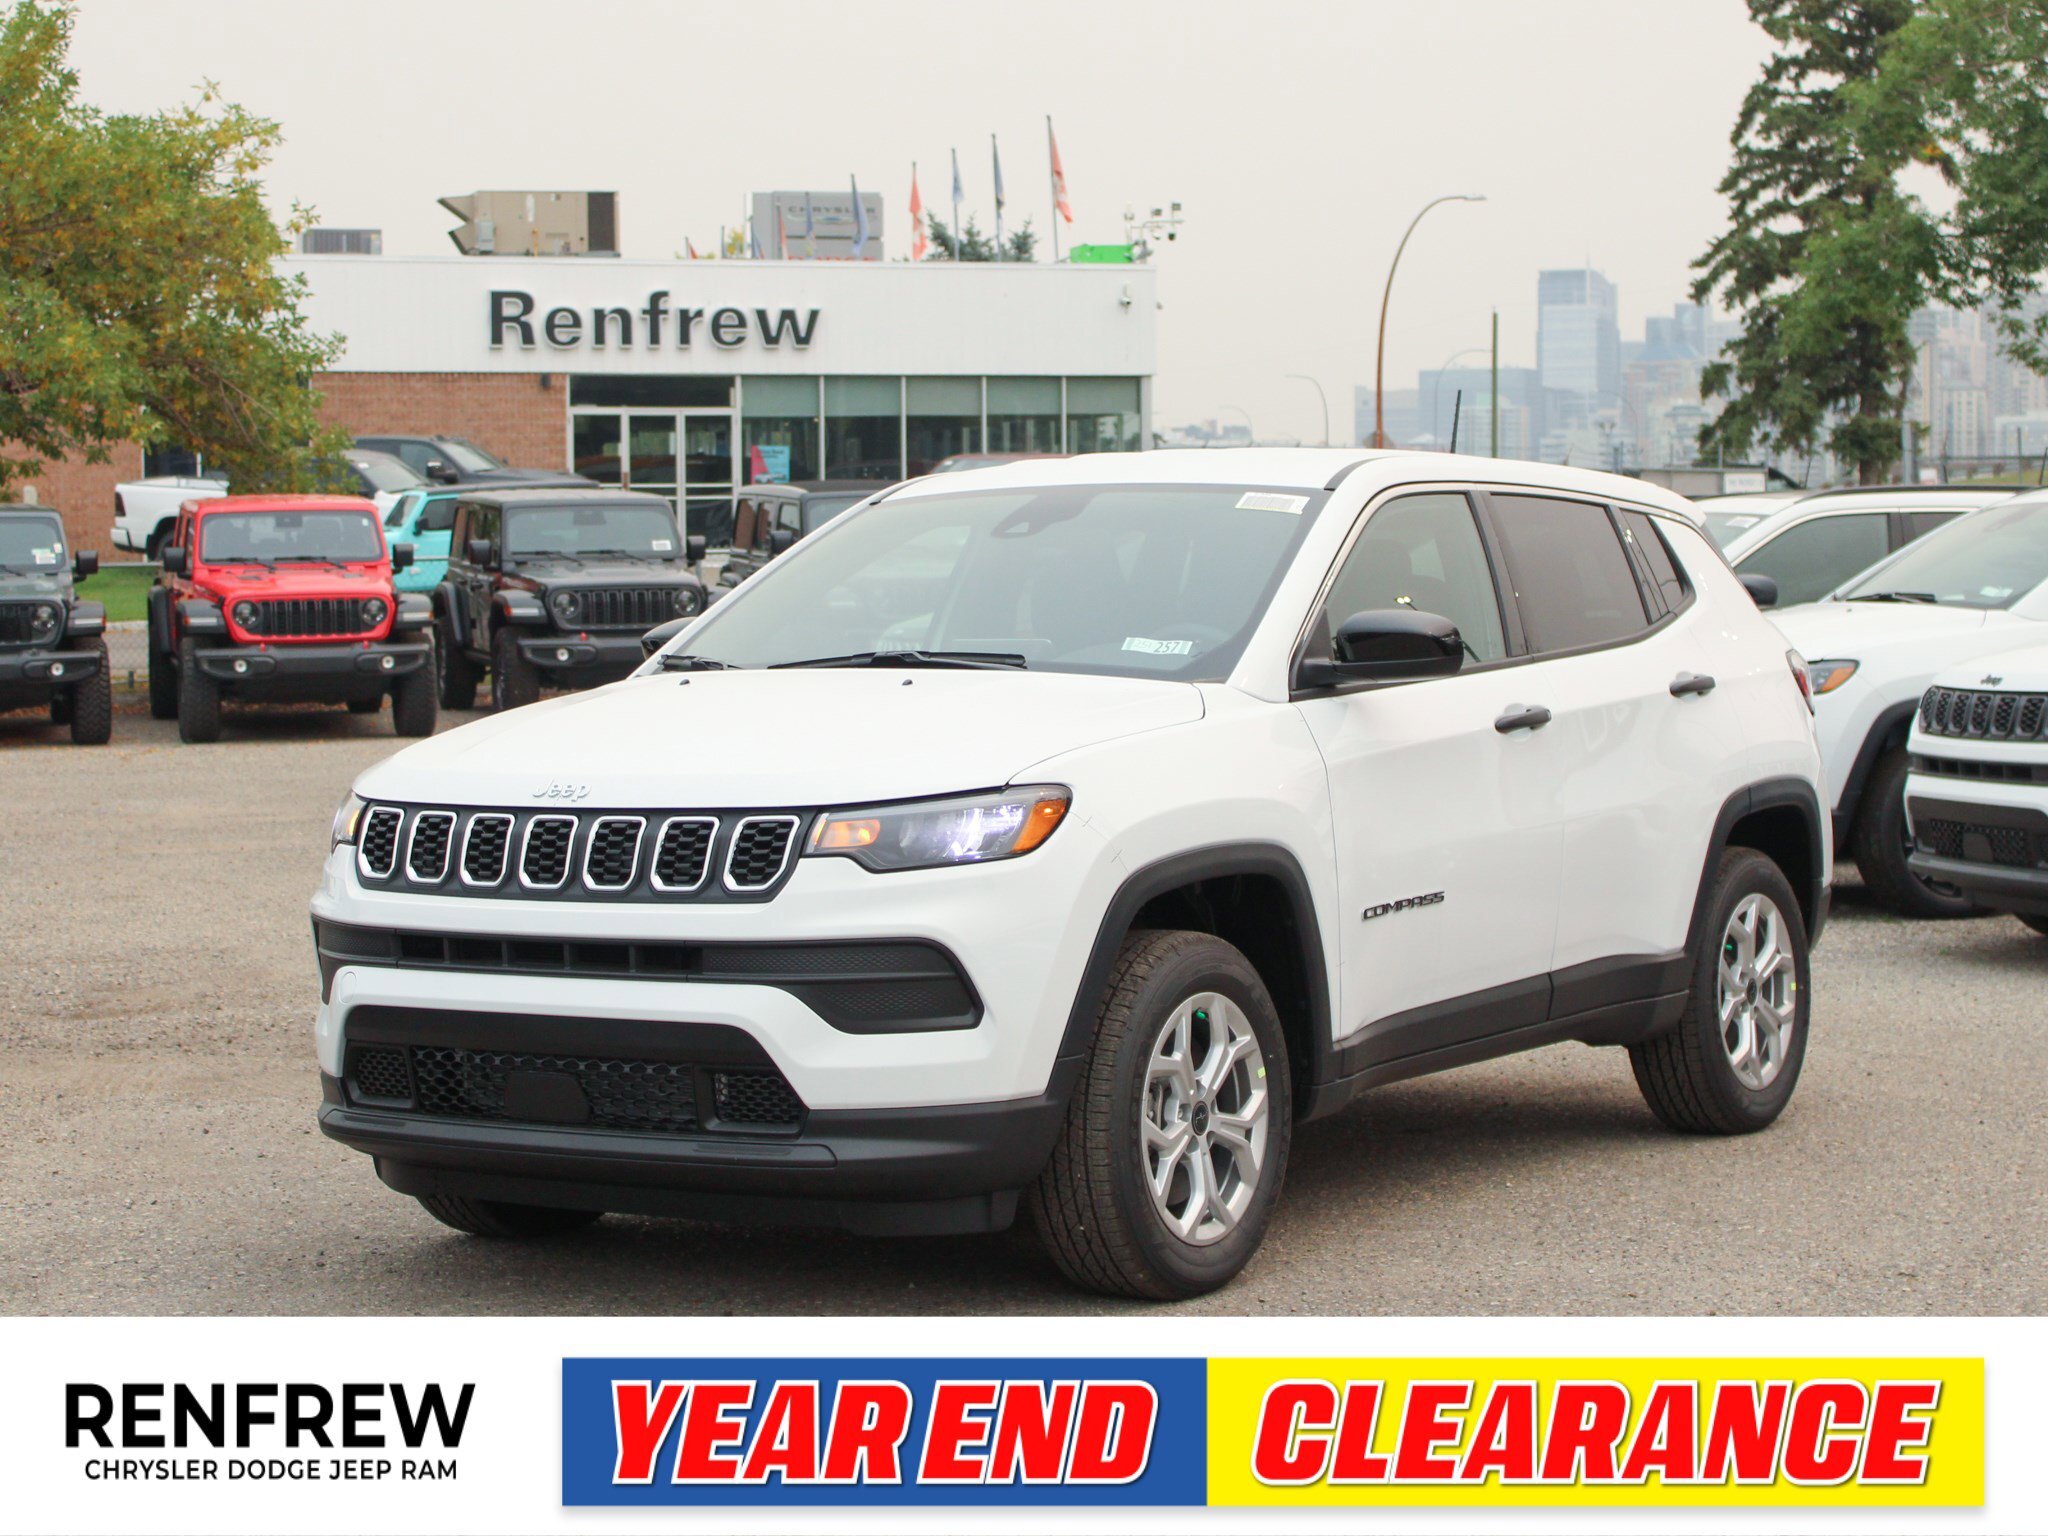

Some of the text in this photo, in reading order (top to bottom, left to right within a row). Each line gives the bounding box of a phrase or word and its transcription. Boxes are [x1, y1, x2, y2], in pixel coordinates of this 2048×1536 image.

[788, 205, 876, 214] CHRYSLR
[489, 290, 821, 350] Renfrew
[532, 779, 592, 803] Jeep
[1362, 890, 1445, 920] COMPASS
